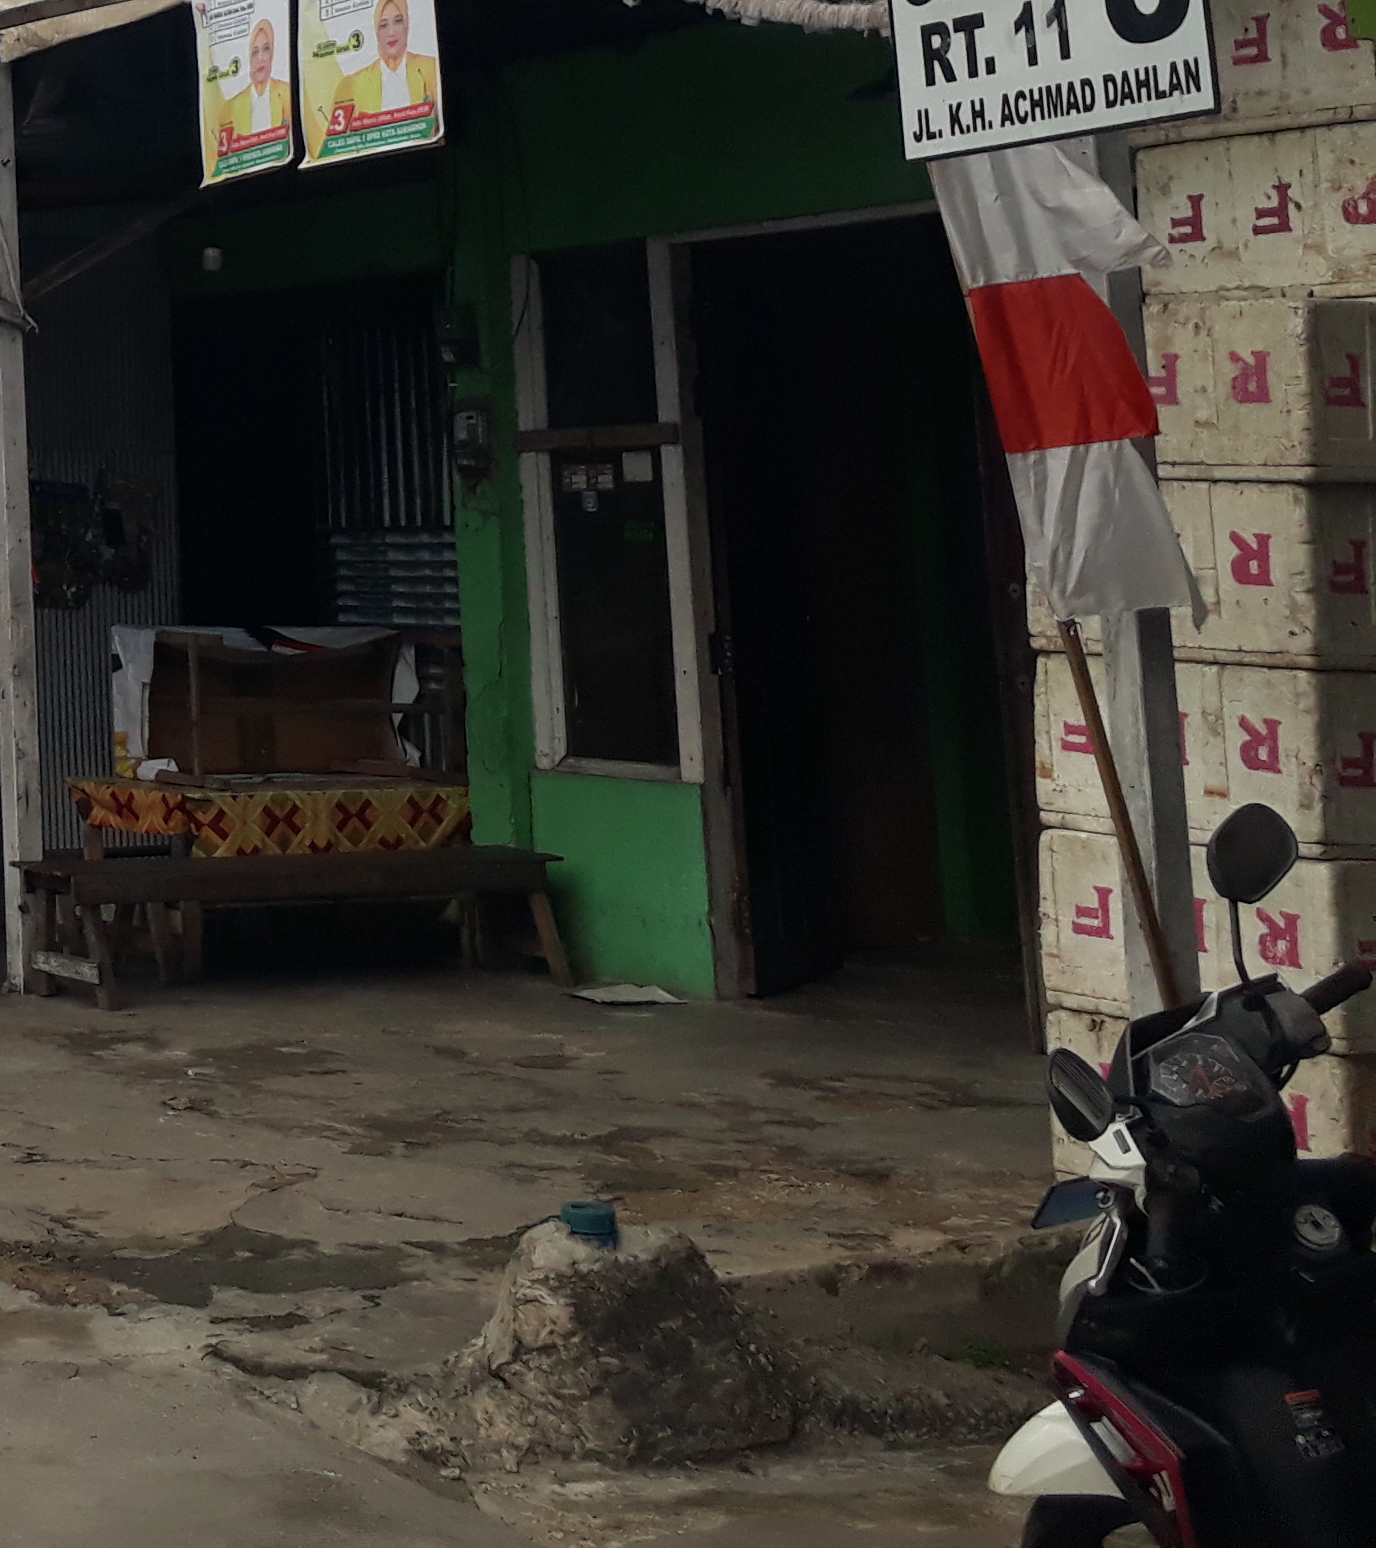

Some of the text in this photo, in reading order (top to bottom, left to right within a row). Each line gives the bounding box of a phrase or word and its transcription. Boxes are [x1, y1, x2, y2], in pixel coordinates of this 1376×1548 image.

[352, 33, 361, 50] 3
[920, 11, 996, 87] RT.
[334, 109, 346, 131] 3
[912, 56, 1202, 143] JL. K.H. ACHMAD DAHLAN
[218, 132, 227, 152] 3
[1168, 193, 1206, 244] F
[1252, 176, 1293, 235] F
[1229, 350, 1273, 404] R
[1229, 531, 1274, 587] R
[1238, 714, 1283, 775] R
[1072, 885, 1115, 940] F
[1256, 906, 1302, 970] R
